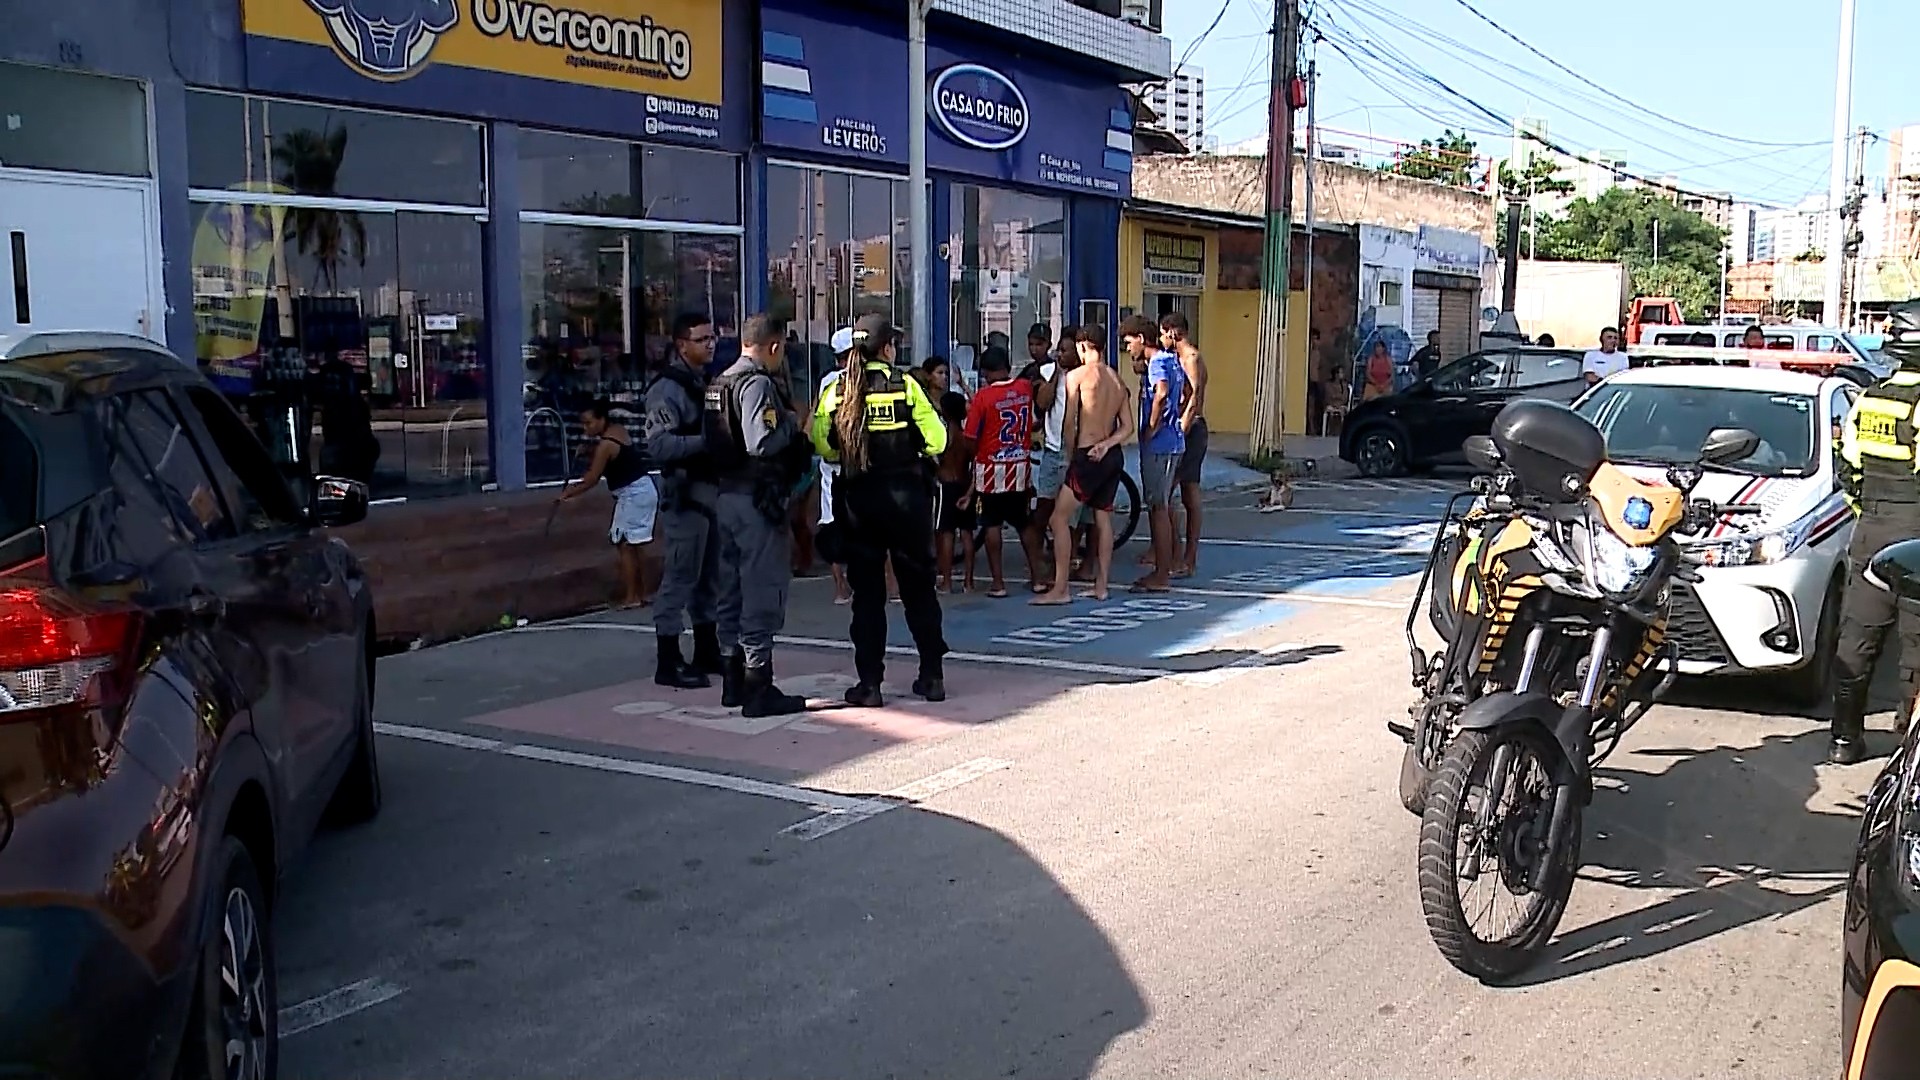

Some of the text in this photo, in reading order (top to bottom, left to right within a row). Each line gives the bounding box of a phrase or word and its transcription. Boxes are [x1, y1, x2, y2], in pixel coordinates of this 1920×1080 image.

[473, 0, 691, 78] Overcoming
[941, 89, 974, 116] CASA
[976, 98, 995, 120] DO
[997, 103, 1023, 127] FRIO
[823, 127, 887, 155] LEVEROS
[999, 405, 1029, 444] 21
[990, 598, 1209, 649] IDOSO
